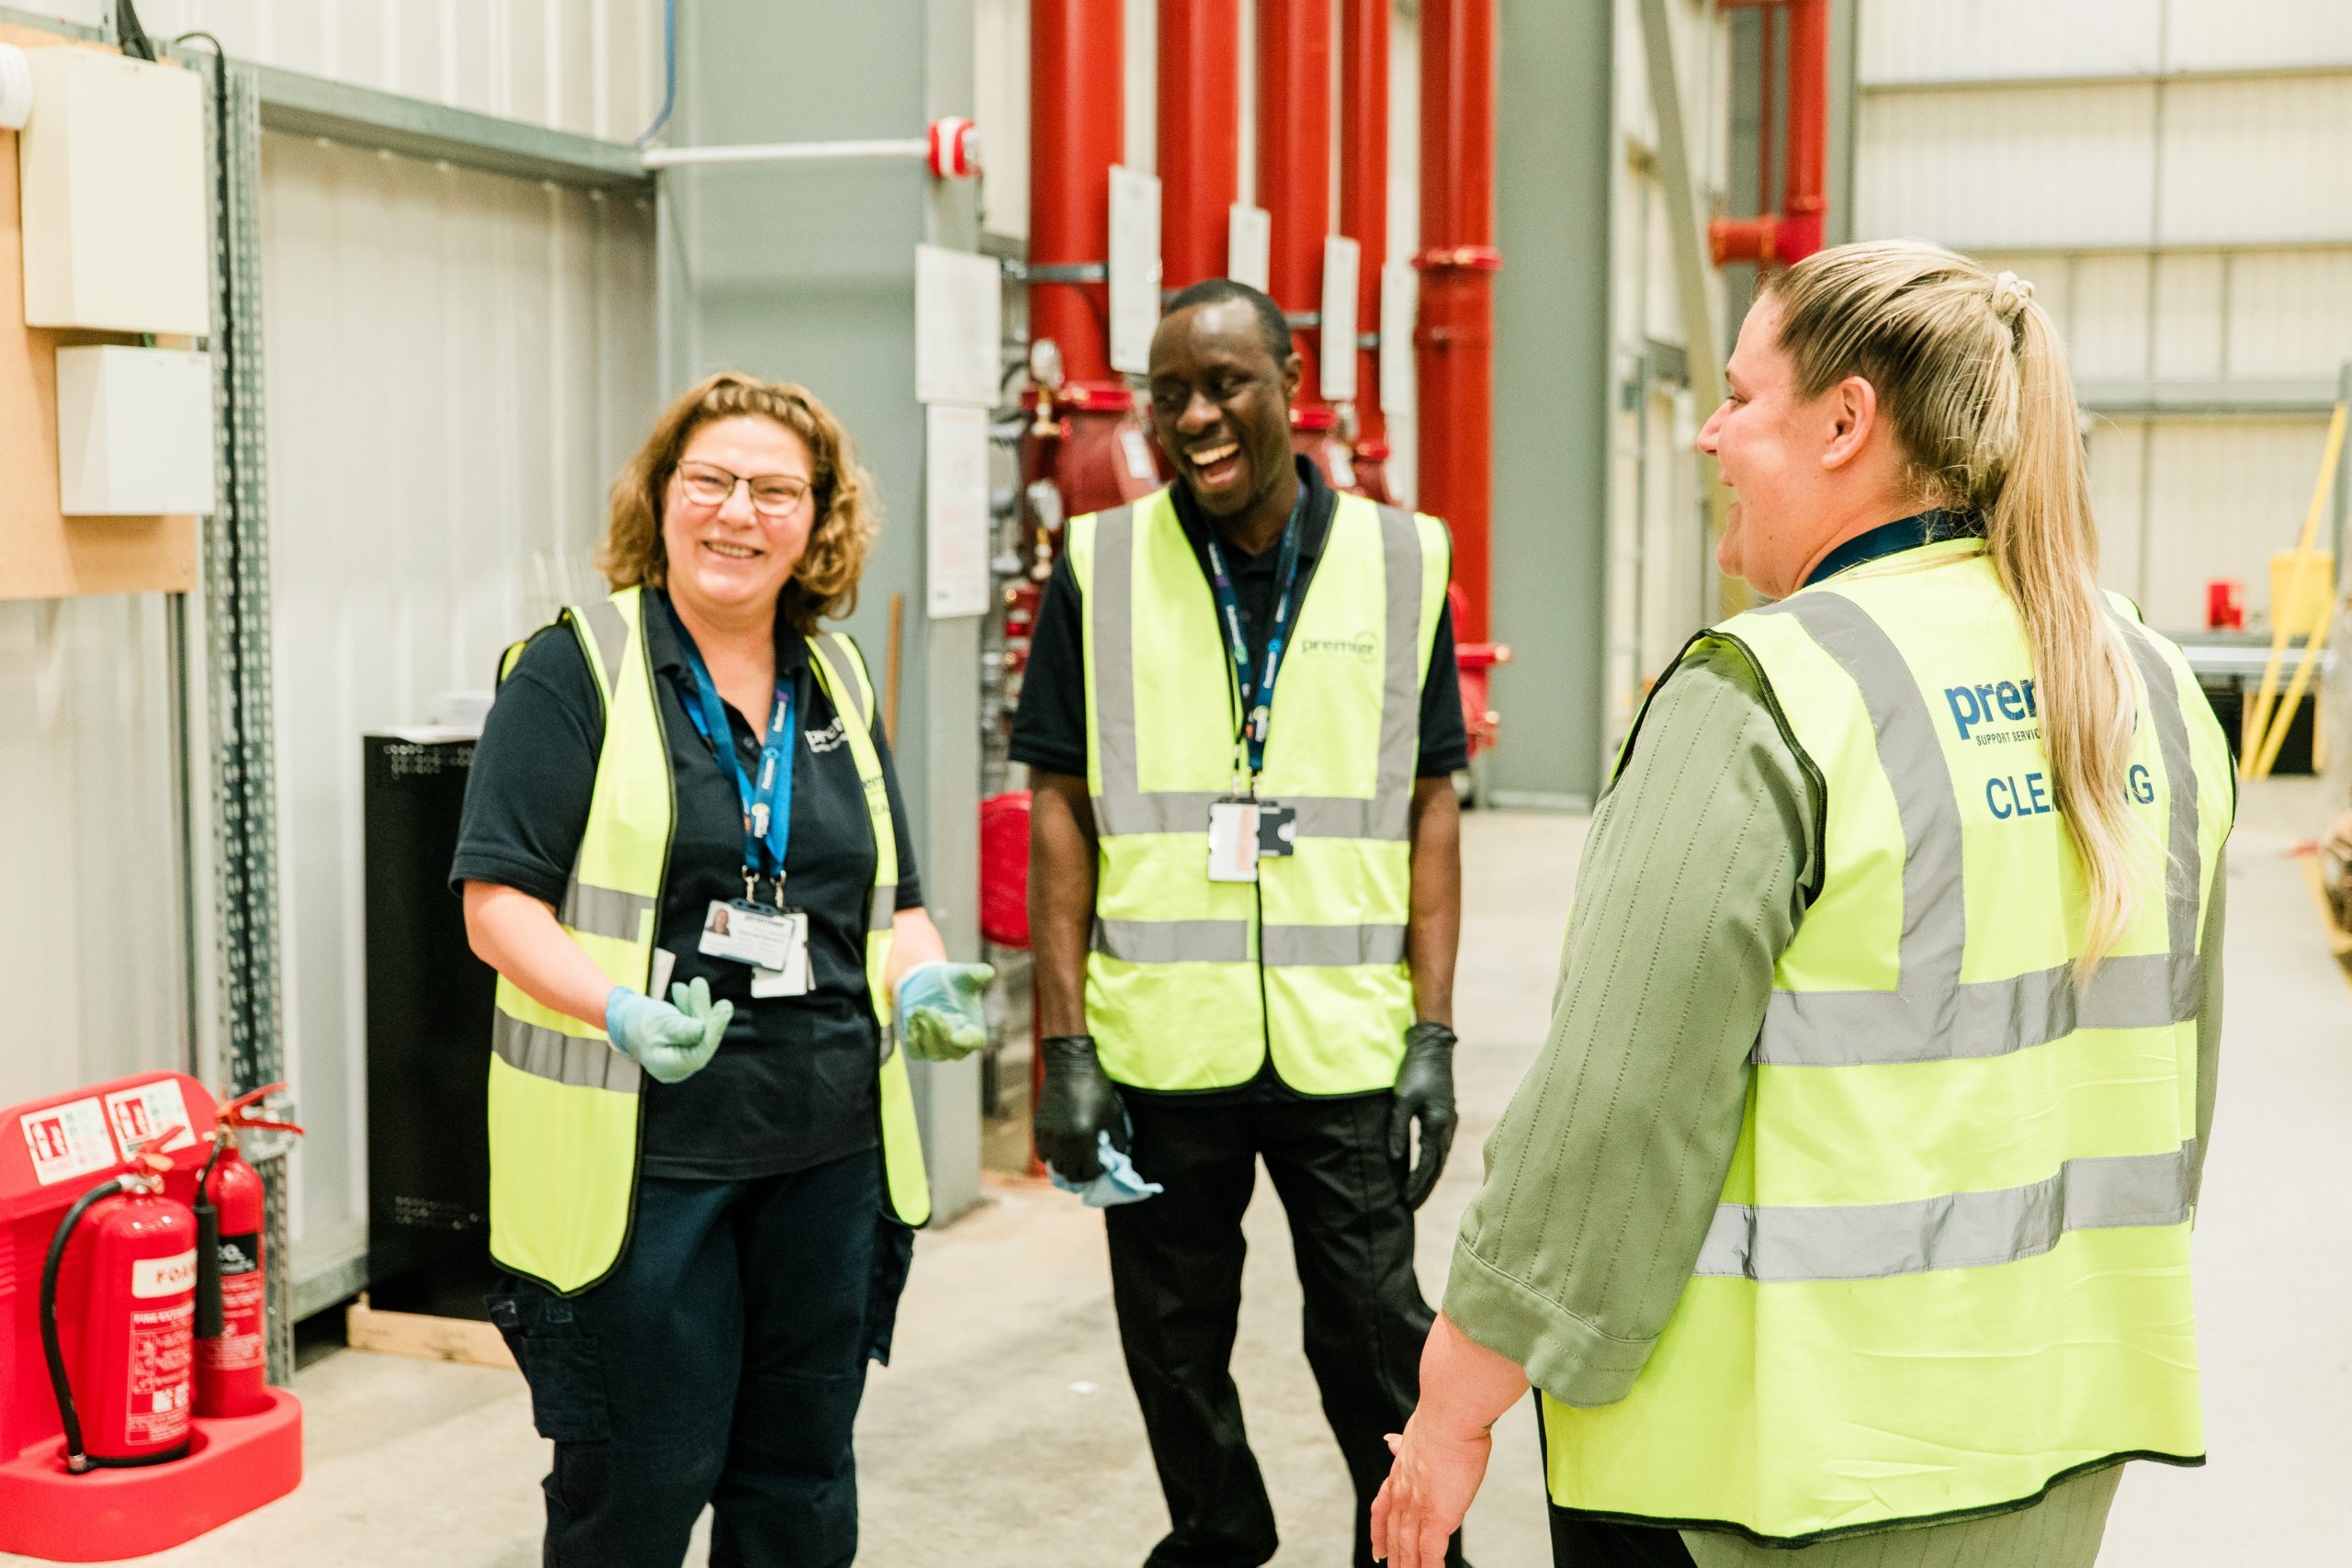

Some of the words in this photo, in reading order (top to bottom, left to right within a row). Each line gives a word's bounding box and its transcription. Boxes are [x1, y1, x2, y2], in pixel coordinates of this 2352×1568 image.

[1975, 732, 2011, 746] SUPPORT
[2011, 728, 2041, 743] SERVIC
[1985, 764, 2154, 819] CLEG
